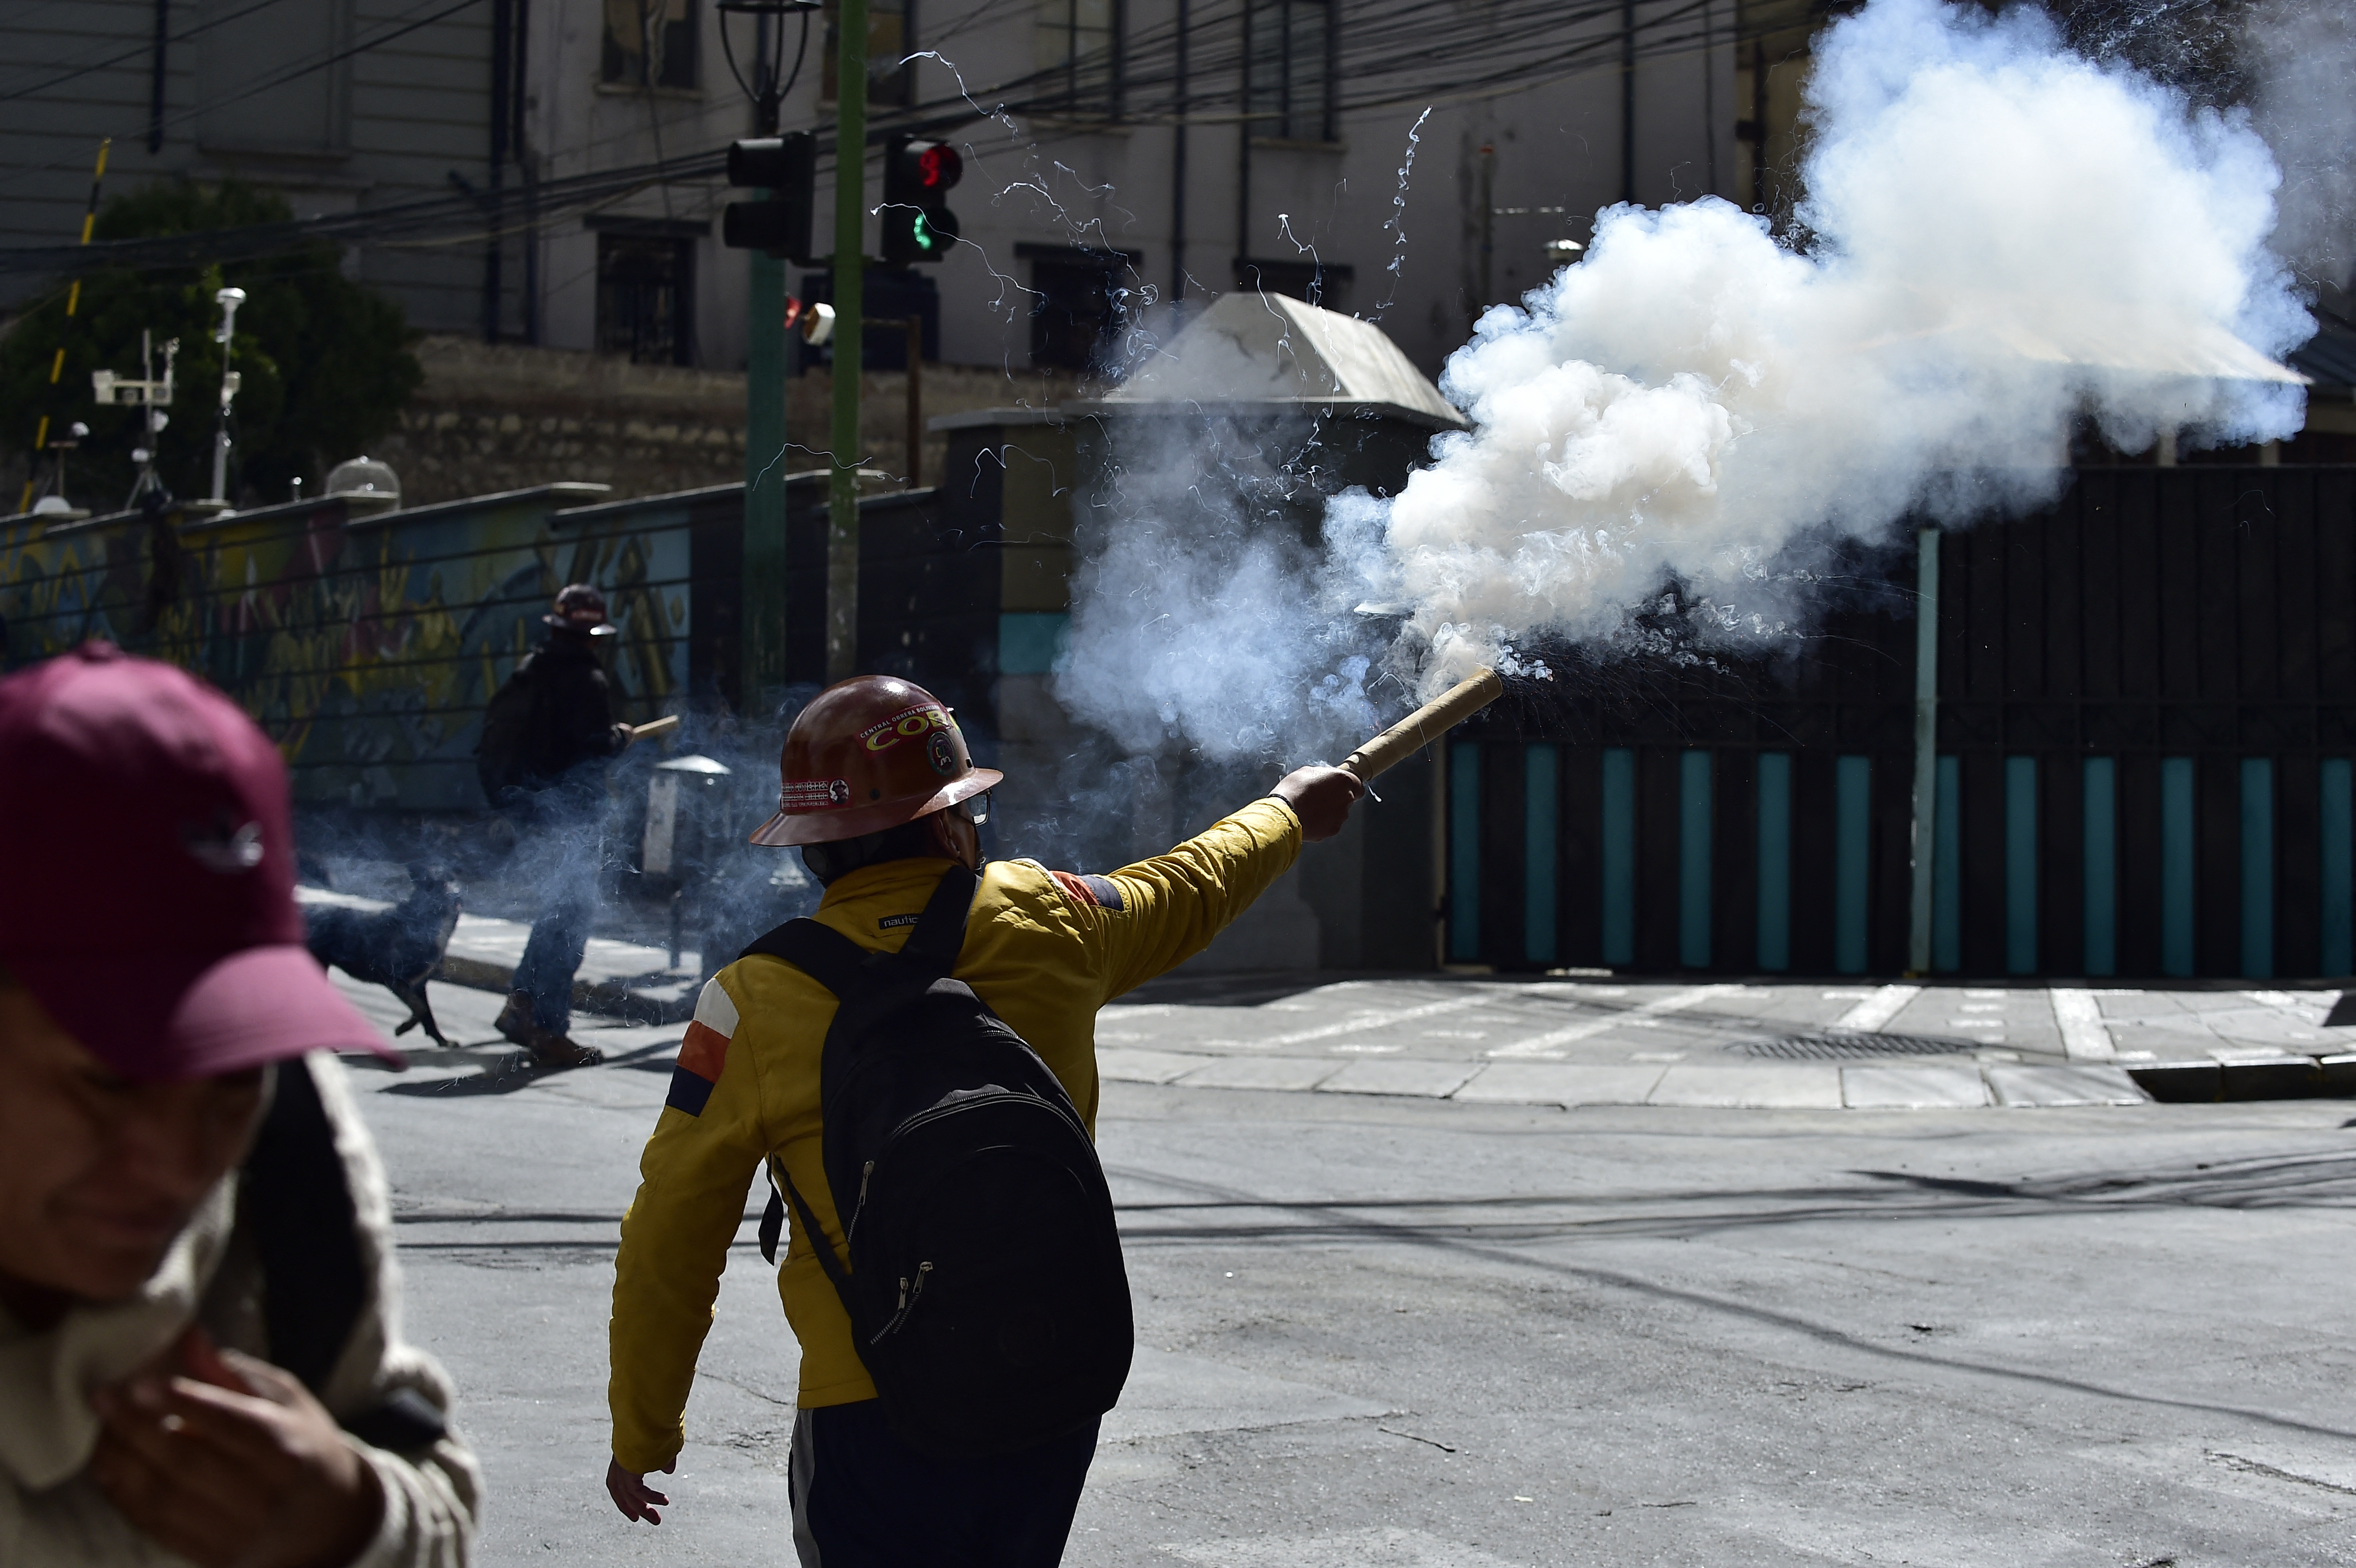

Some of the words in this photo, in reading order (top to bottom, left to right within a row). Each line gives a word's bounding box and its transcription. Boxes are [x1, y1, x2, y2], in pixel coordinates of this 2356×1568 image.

[860, 720, 891, 739] CENTRAL
[891, 710, 916, 722] OBRERA
[884, 915, 919, 927] nautic
